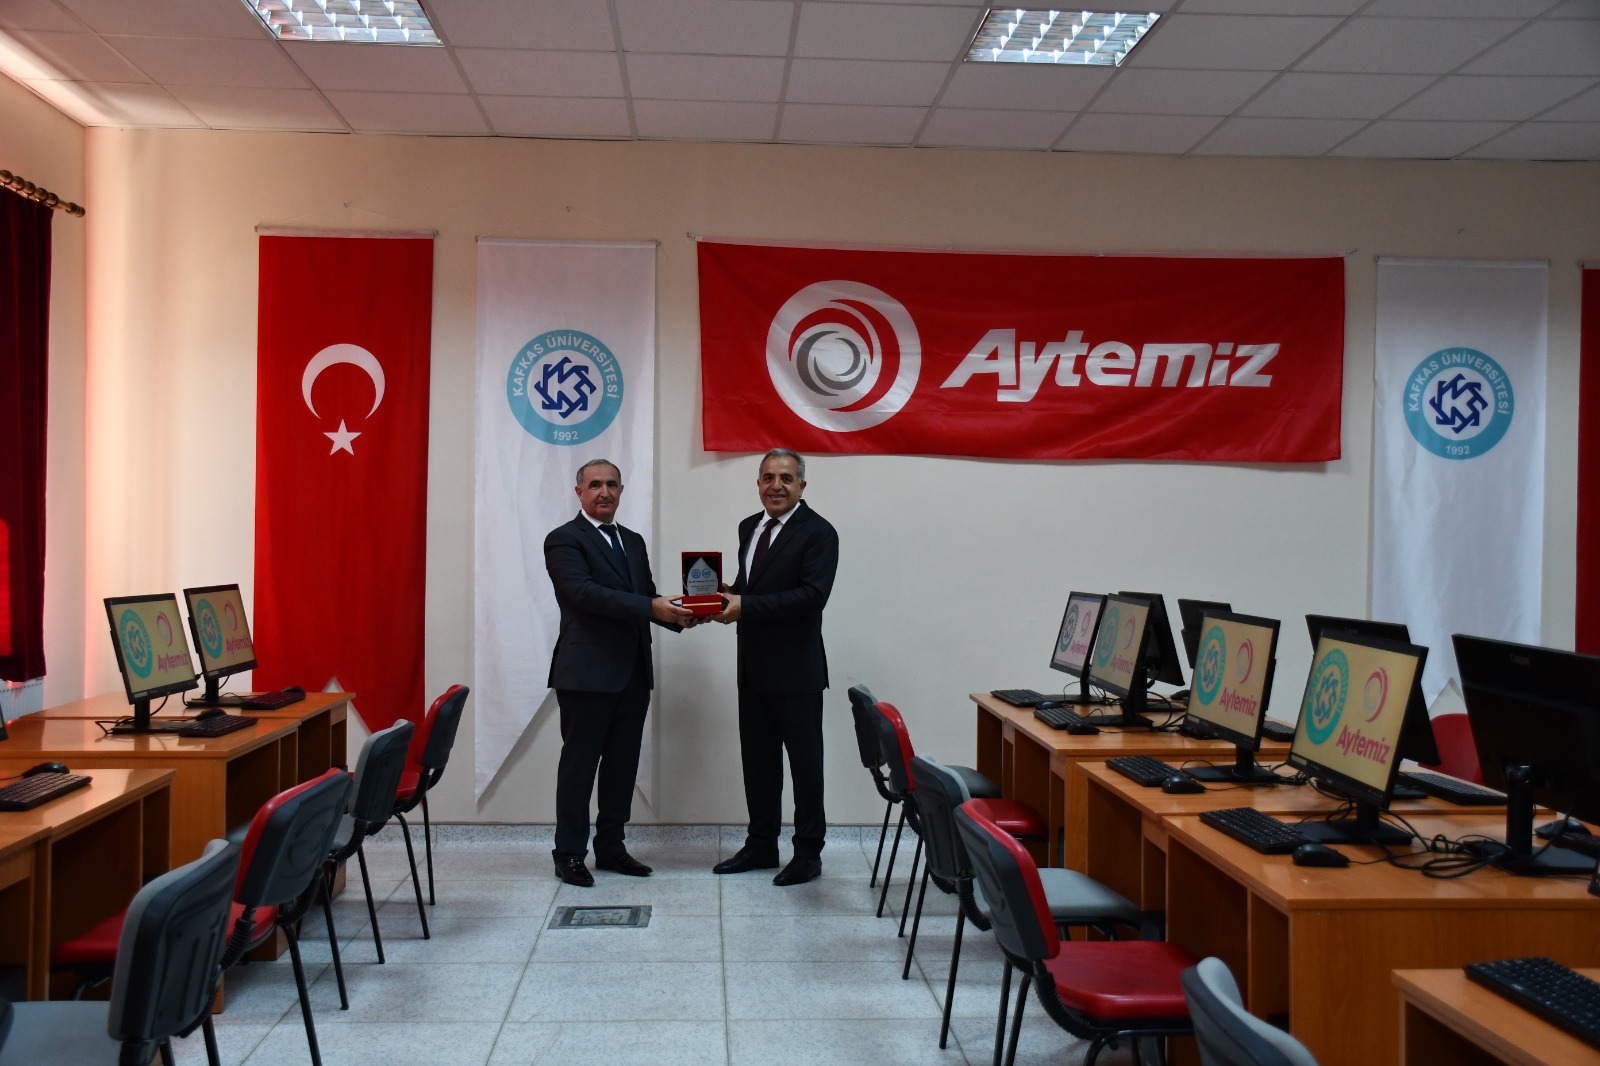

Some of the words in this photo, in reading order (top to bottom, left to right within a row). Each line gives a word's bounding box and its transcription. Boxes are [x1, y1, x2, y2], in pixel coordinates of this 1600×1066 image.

[512, 344, 544, 397] KAFKAS
[545, 333, 620, 399] ÜNİVERSİTESİ
[939, 328, 1281, 403] Aytemiz
[1408, 360, 1439, 412] KAFKAS
[1441, 351, 1510, 415] ÜNİVERSİTESİ
[553, 430, 579, 441] 1992
[1446, 445, 1471, 456] 1992
[1219, 687, 1257, 717] Aytemiz
[1336, 725, 1391, 765] Aytemiz
